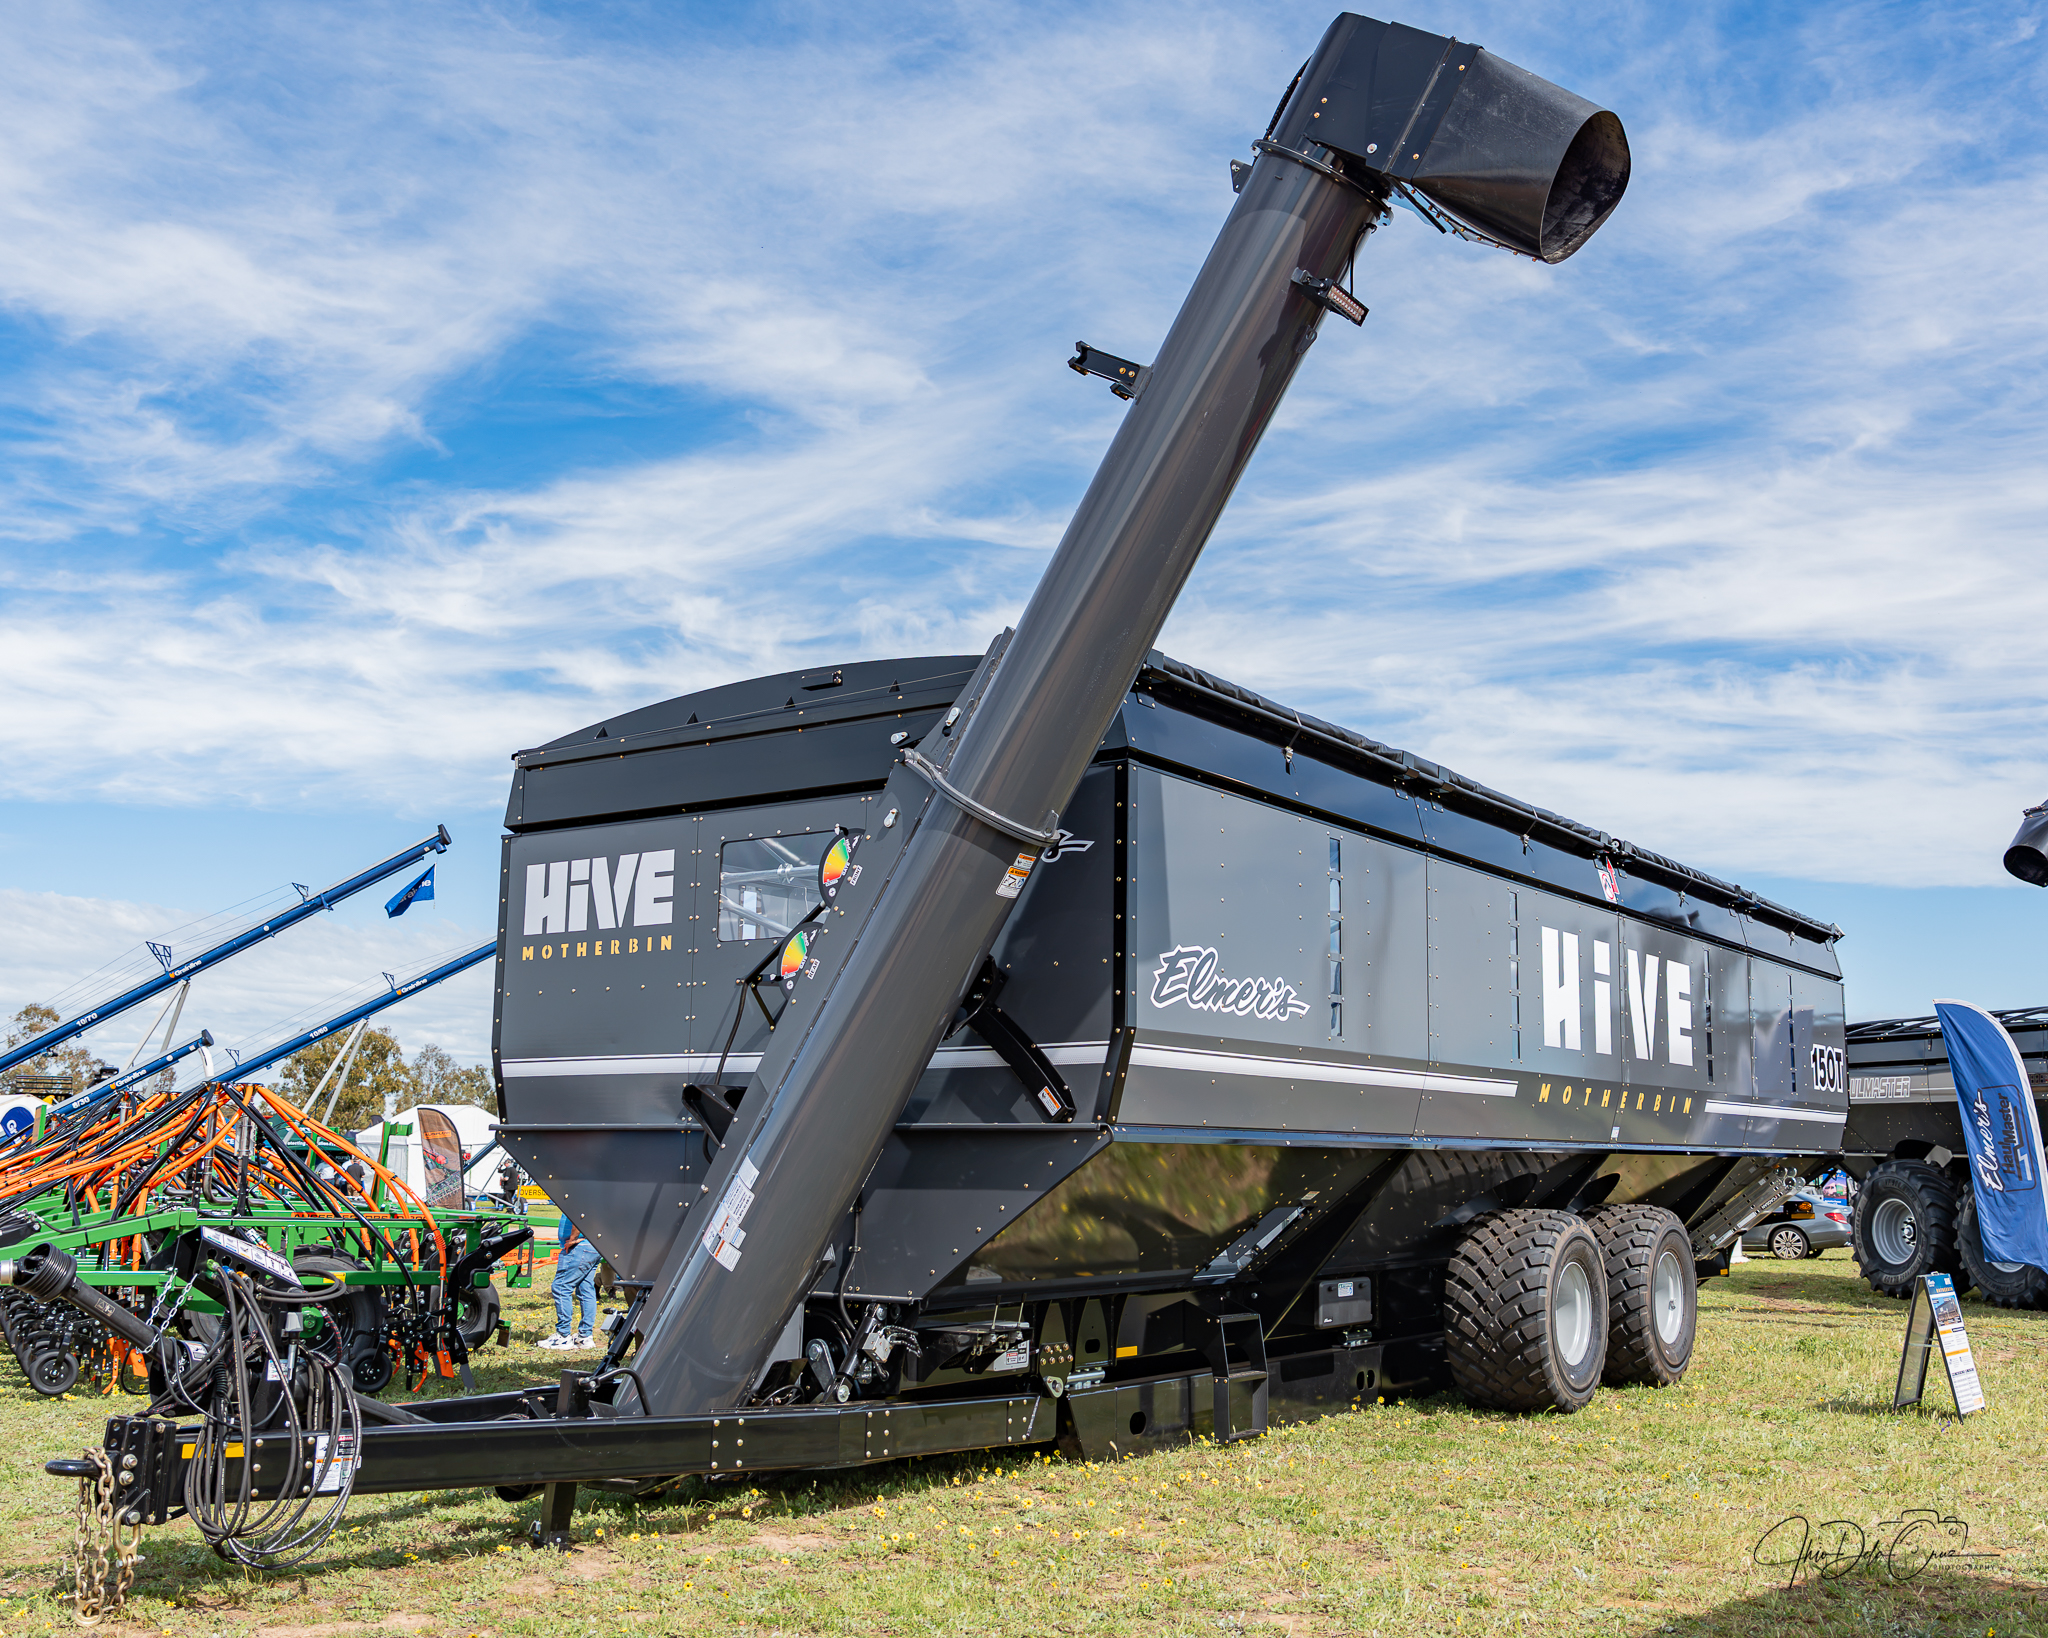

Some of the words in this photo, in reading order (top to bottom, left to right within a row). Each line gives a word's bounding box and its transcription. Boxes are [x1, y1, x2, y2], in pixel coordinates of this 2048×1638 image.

[522, 935, 673, 961] MOTHERBIN
[1150, 944, 1311, 1022] Elmer's
[76, 1012, 98, 1027] 10/70
[72, 1096, 91, 1109] 8/30
[1538, 1083, 1692, 1114] MOTHERBIN
[1973, 1089, 2005, 1192] Elmer's
